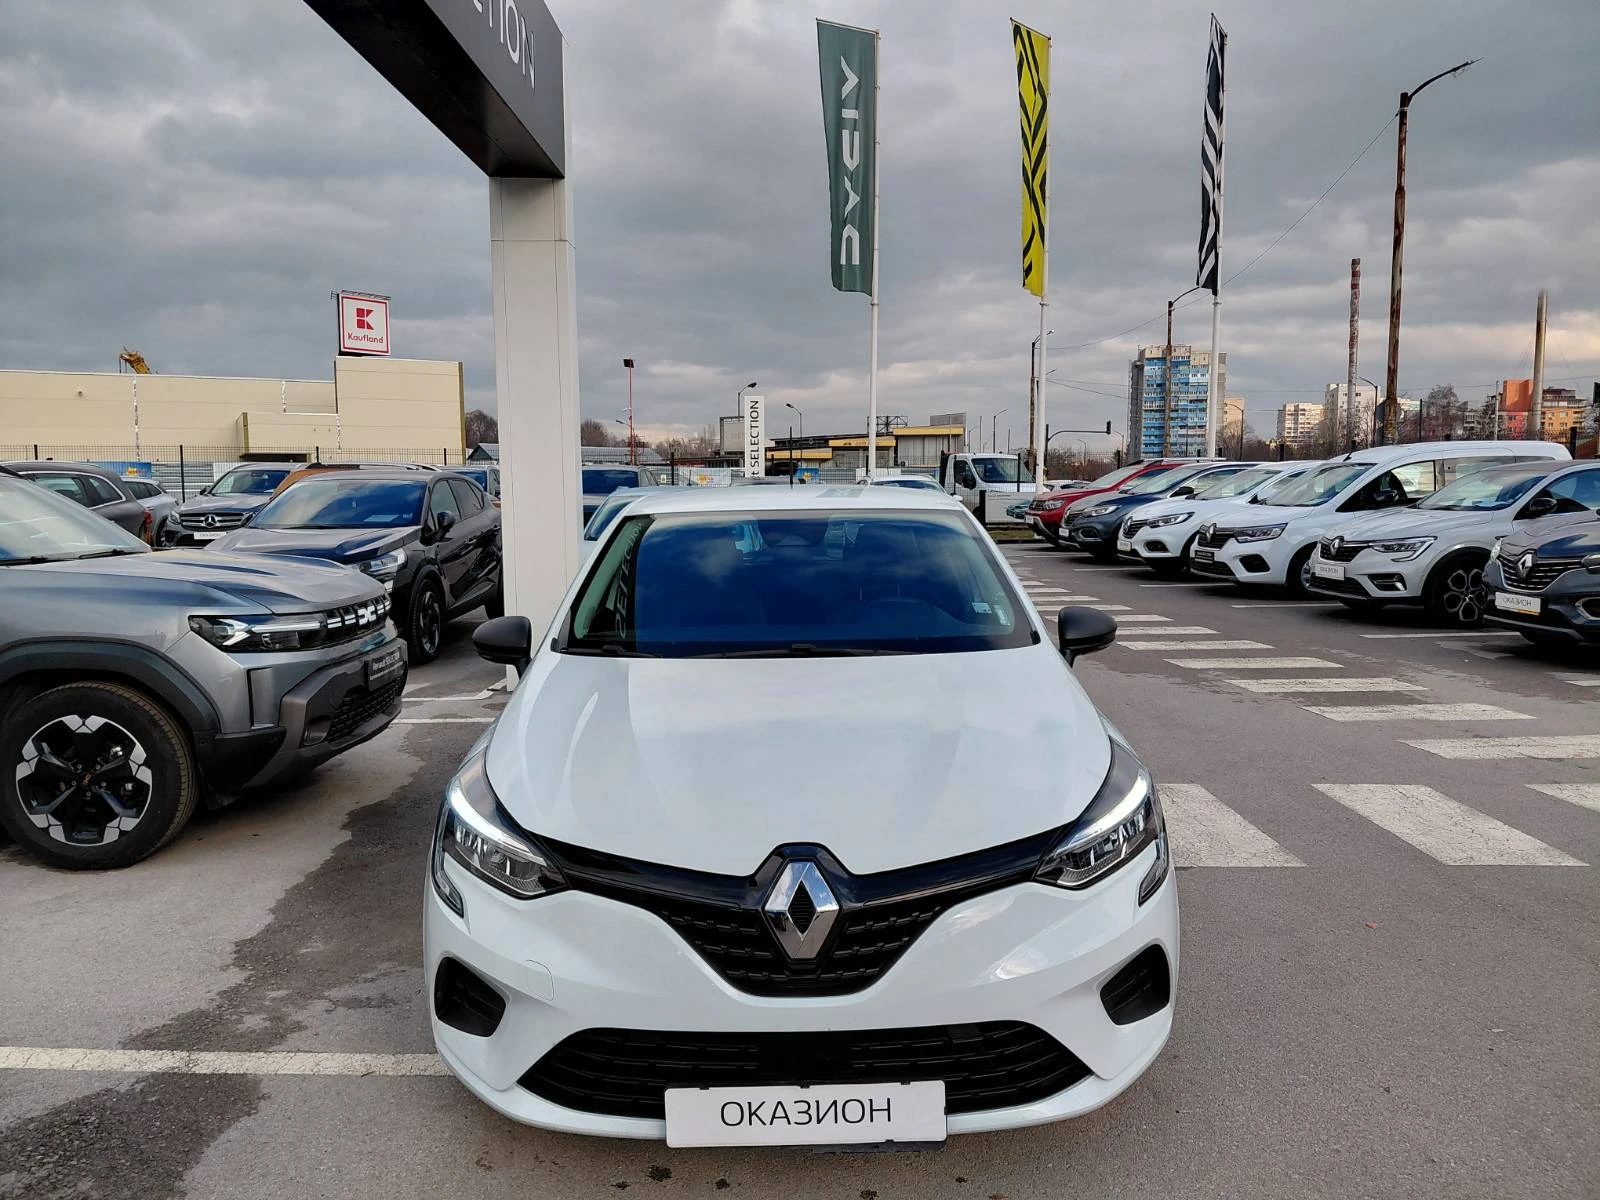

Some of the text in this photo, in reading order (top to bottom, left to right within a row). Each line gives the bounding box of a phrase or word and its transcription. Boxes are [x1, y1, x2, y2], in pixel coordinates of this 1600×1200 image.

[347, 332, 384, 344] Kaufland
[750, 400, 760, 469] SELECTION
[720, 1097, 892, 1127] ОКАЗИОН
